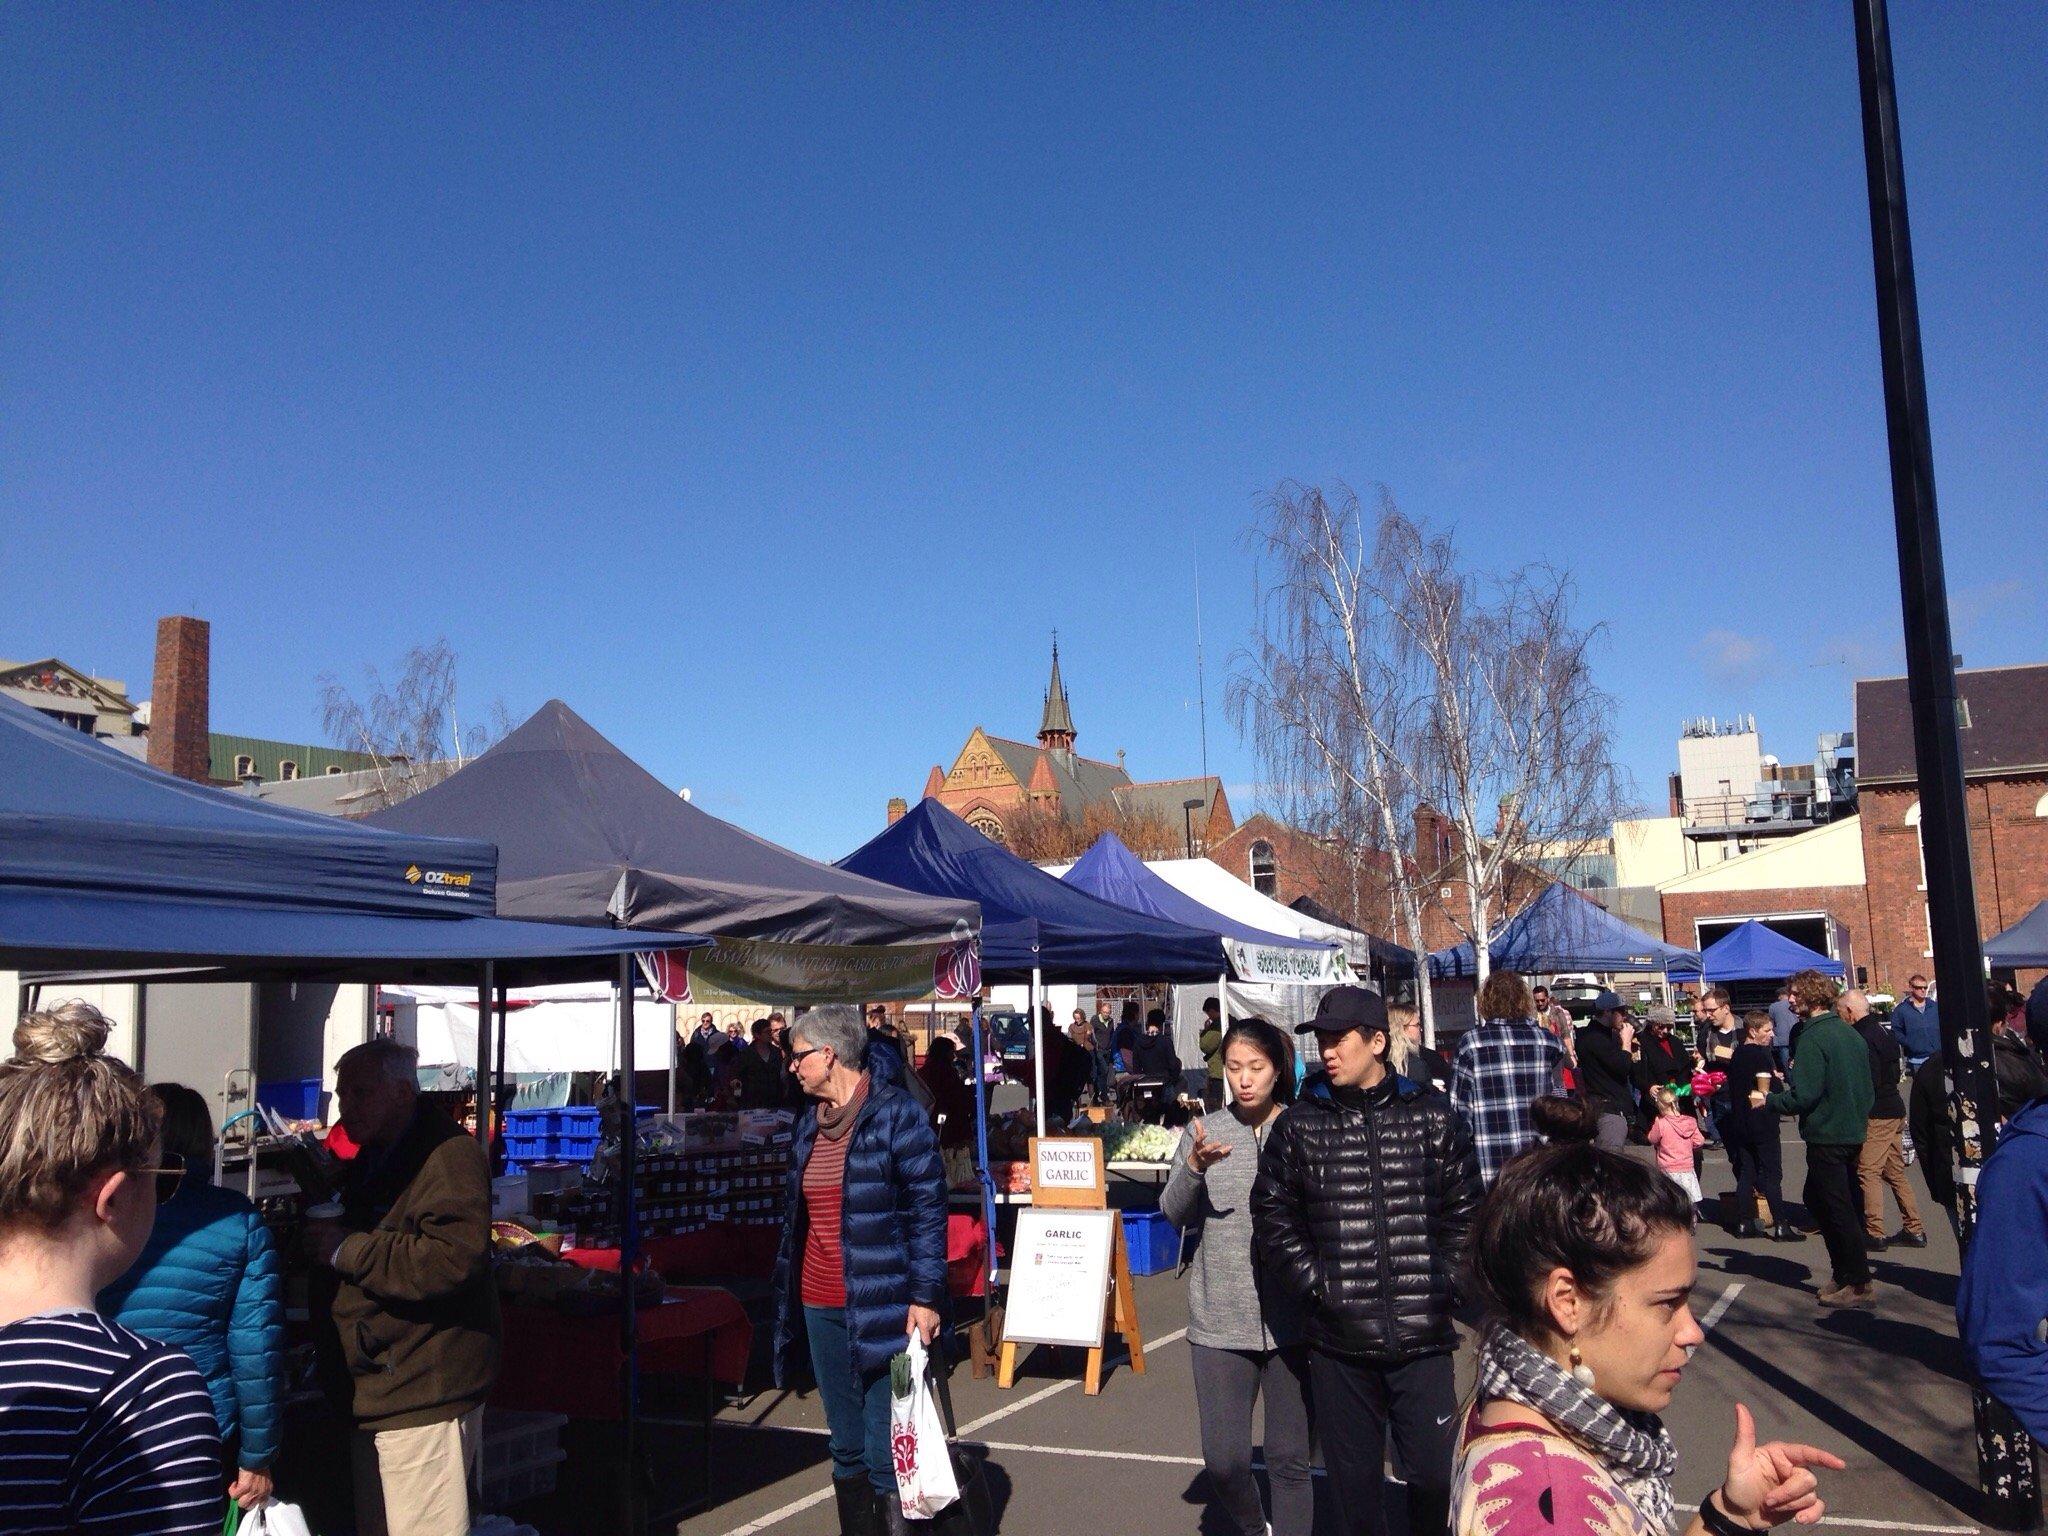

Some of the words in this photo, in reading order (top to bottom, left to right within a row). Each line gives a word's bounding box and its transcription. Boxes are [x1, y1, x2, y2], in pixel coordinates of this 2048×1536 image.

[424, 871, 471, 886] OZtrail
[790, 956, 841, 972] NATURAL
[844, 957, 880, 971] GARLIC
[1040, 1150, 1092, 1162] SMOKED
[1046, 1169, 1089, 1181] GARLIC
[1045, 1229, 1082, 1239] GARLIC
